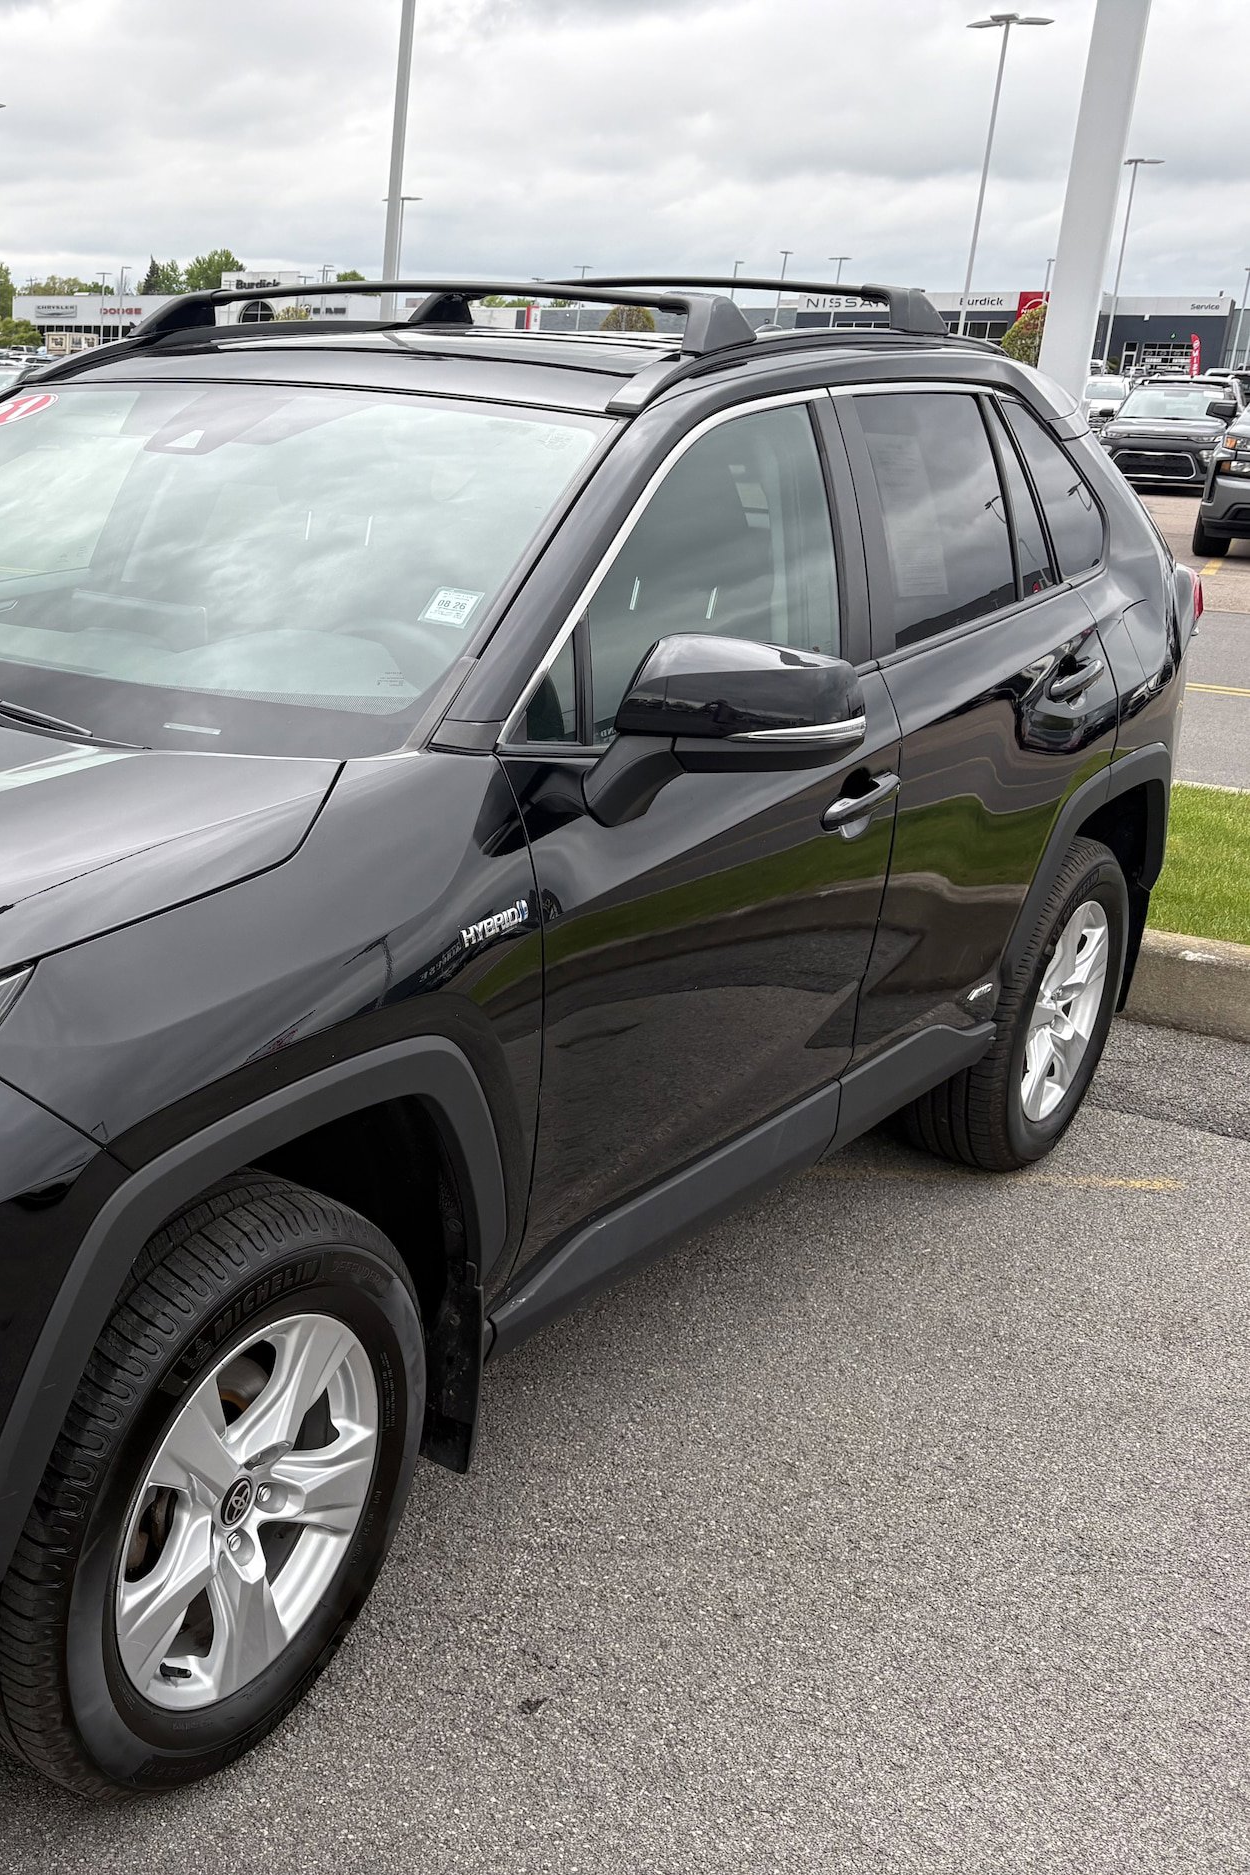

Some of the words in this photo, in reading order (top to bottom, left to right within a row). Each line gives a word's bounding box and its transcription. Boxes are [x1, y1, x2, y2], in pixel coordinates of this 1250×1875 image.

[437, 599, 451, 608] 08
[452, 601, 468, 610] 26
[461, 907, 518, 948] HYBRID
[214, 1259, 319, 1342] MICHELIN
